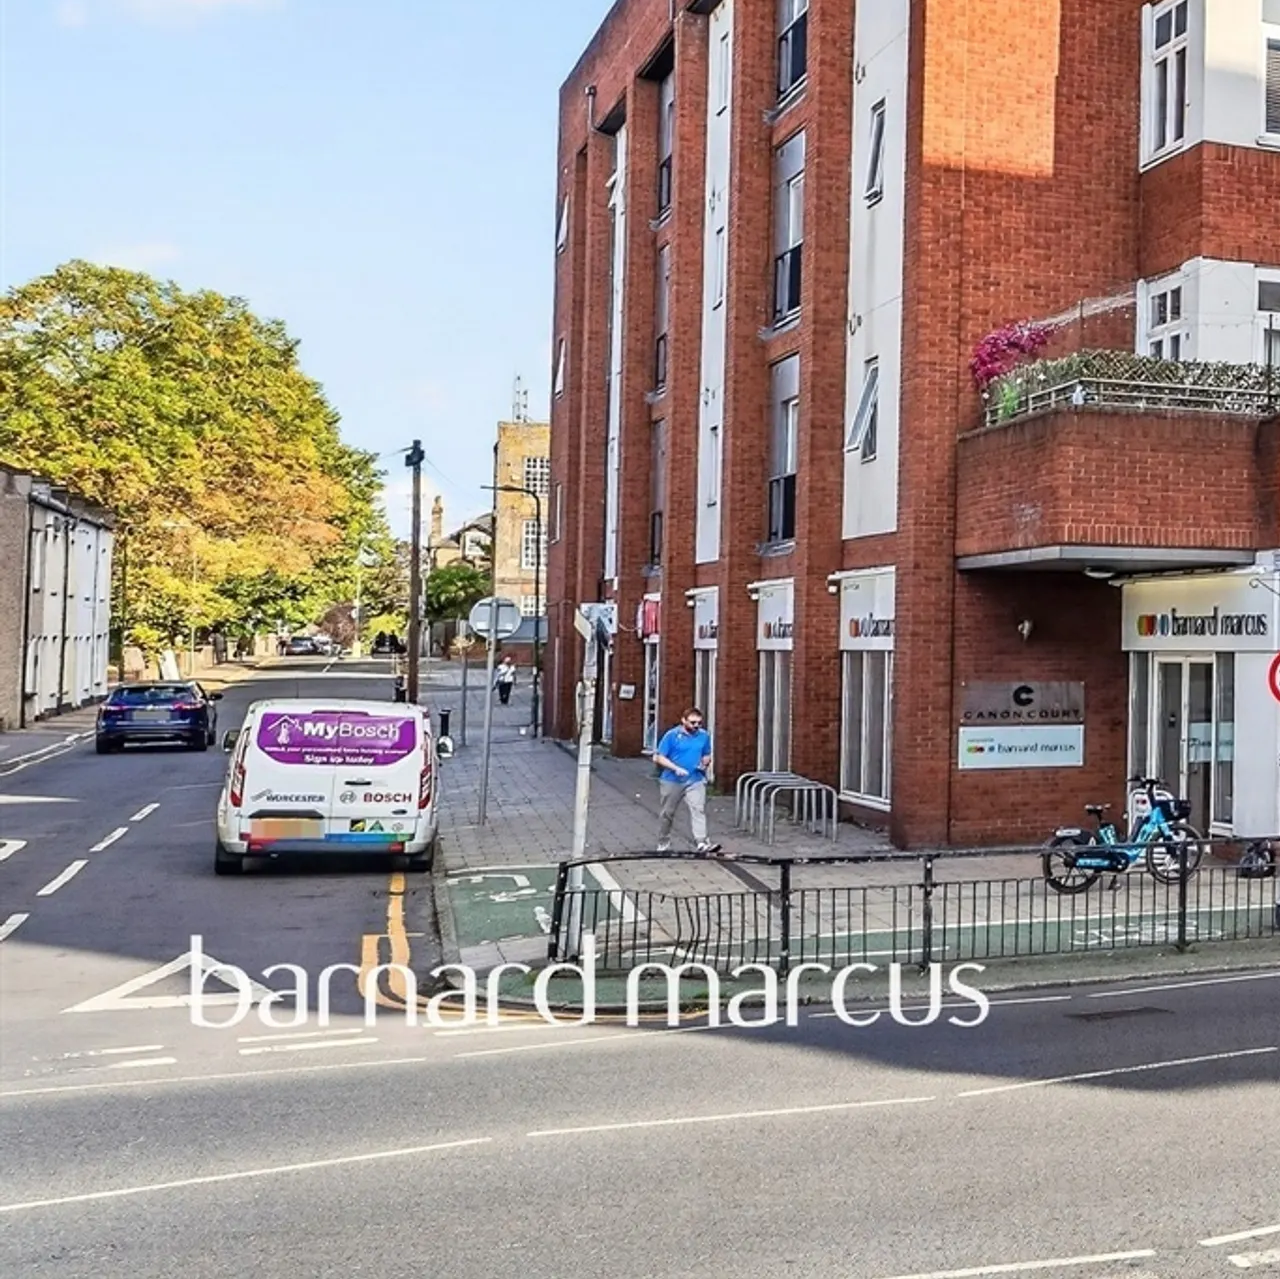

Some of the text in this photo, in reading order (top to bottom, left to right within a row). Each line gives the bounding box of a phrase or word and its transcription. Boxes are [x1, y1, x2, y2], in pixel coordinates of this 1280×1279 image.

[1171, 606, 1267, 636] barnard marcus
[963, 709, 1080, 720] CANON COURT
[303, 721, 399, 739] MyBosch
[304, 755, 327, 764] Sign
[266, 793, 412, 803] WORCESTER BOSCH
